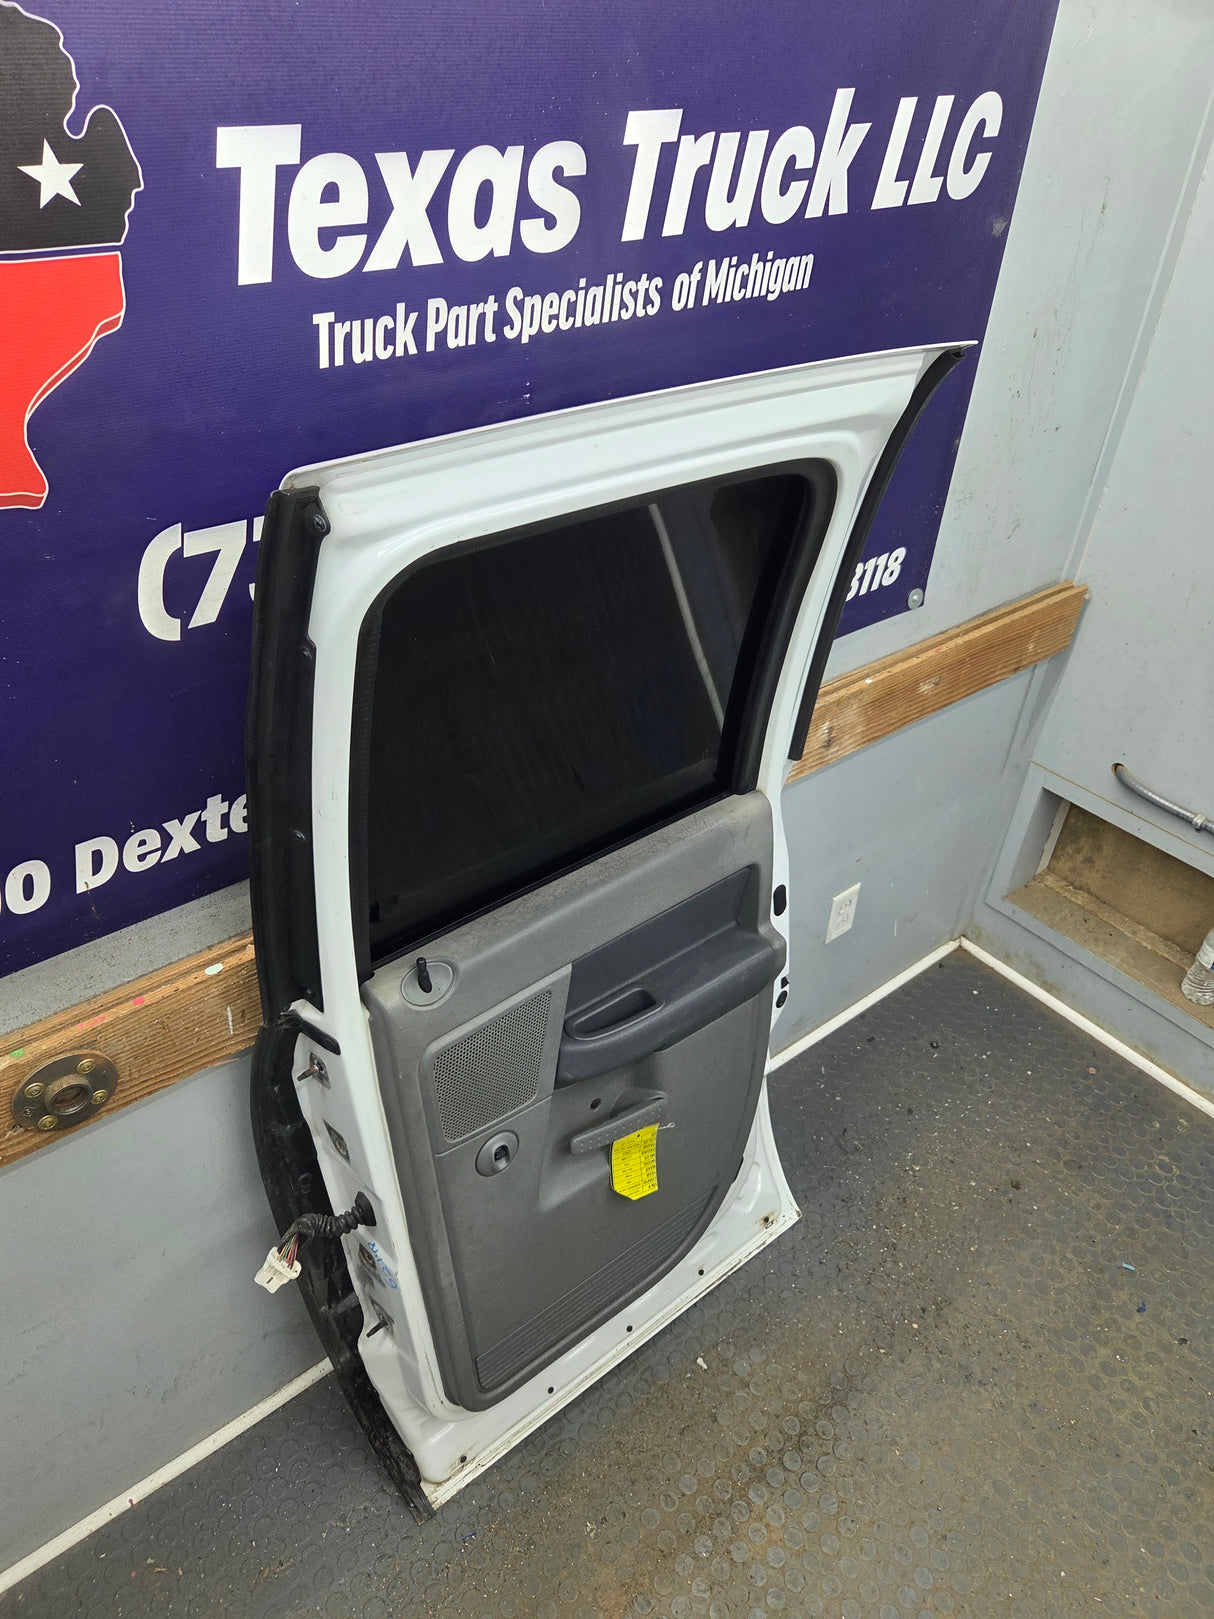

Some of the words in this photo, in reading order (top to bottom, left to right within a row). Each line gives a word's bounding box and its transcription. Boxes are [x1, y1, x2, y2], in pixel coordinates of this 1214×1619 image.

[215, 123, 588, 287] Texas
[620, 87, 873, 243] Truck
[870, 90, 1005, 211] LLC
[312, 302, 419, 370] Truck
[425, 294, 499, 353] Part
[503, 272, 663, 343] Specialists
[671, 260, 705, 312] of
[701, 252, 815, 308] Michigan
